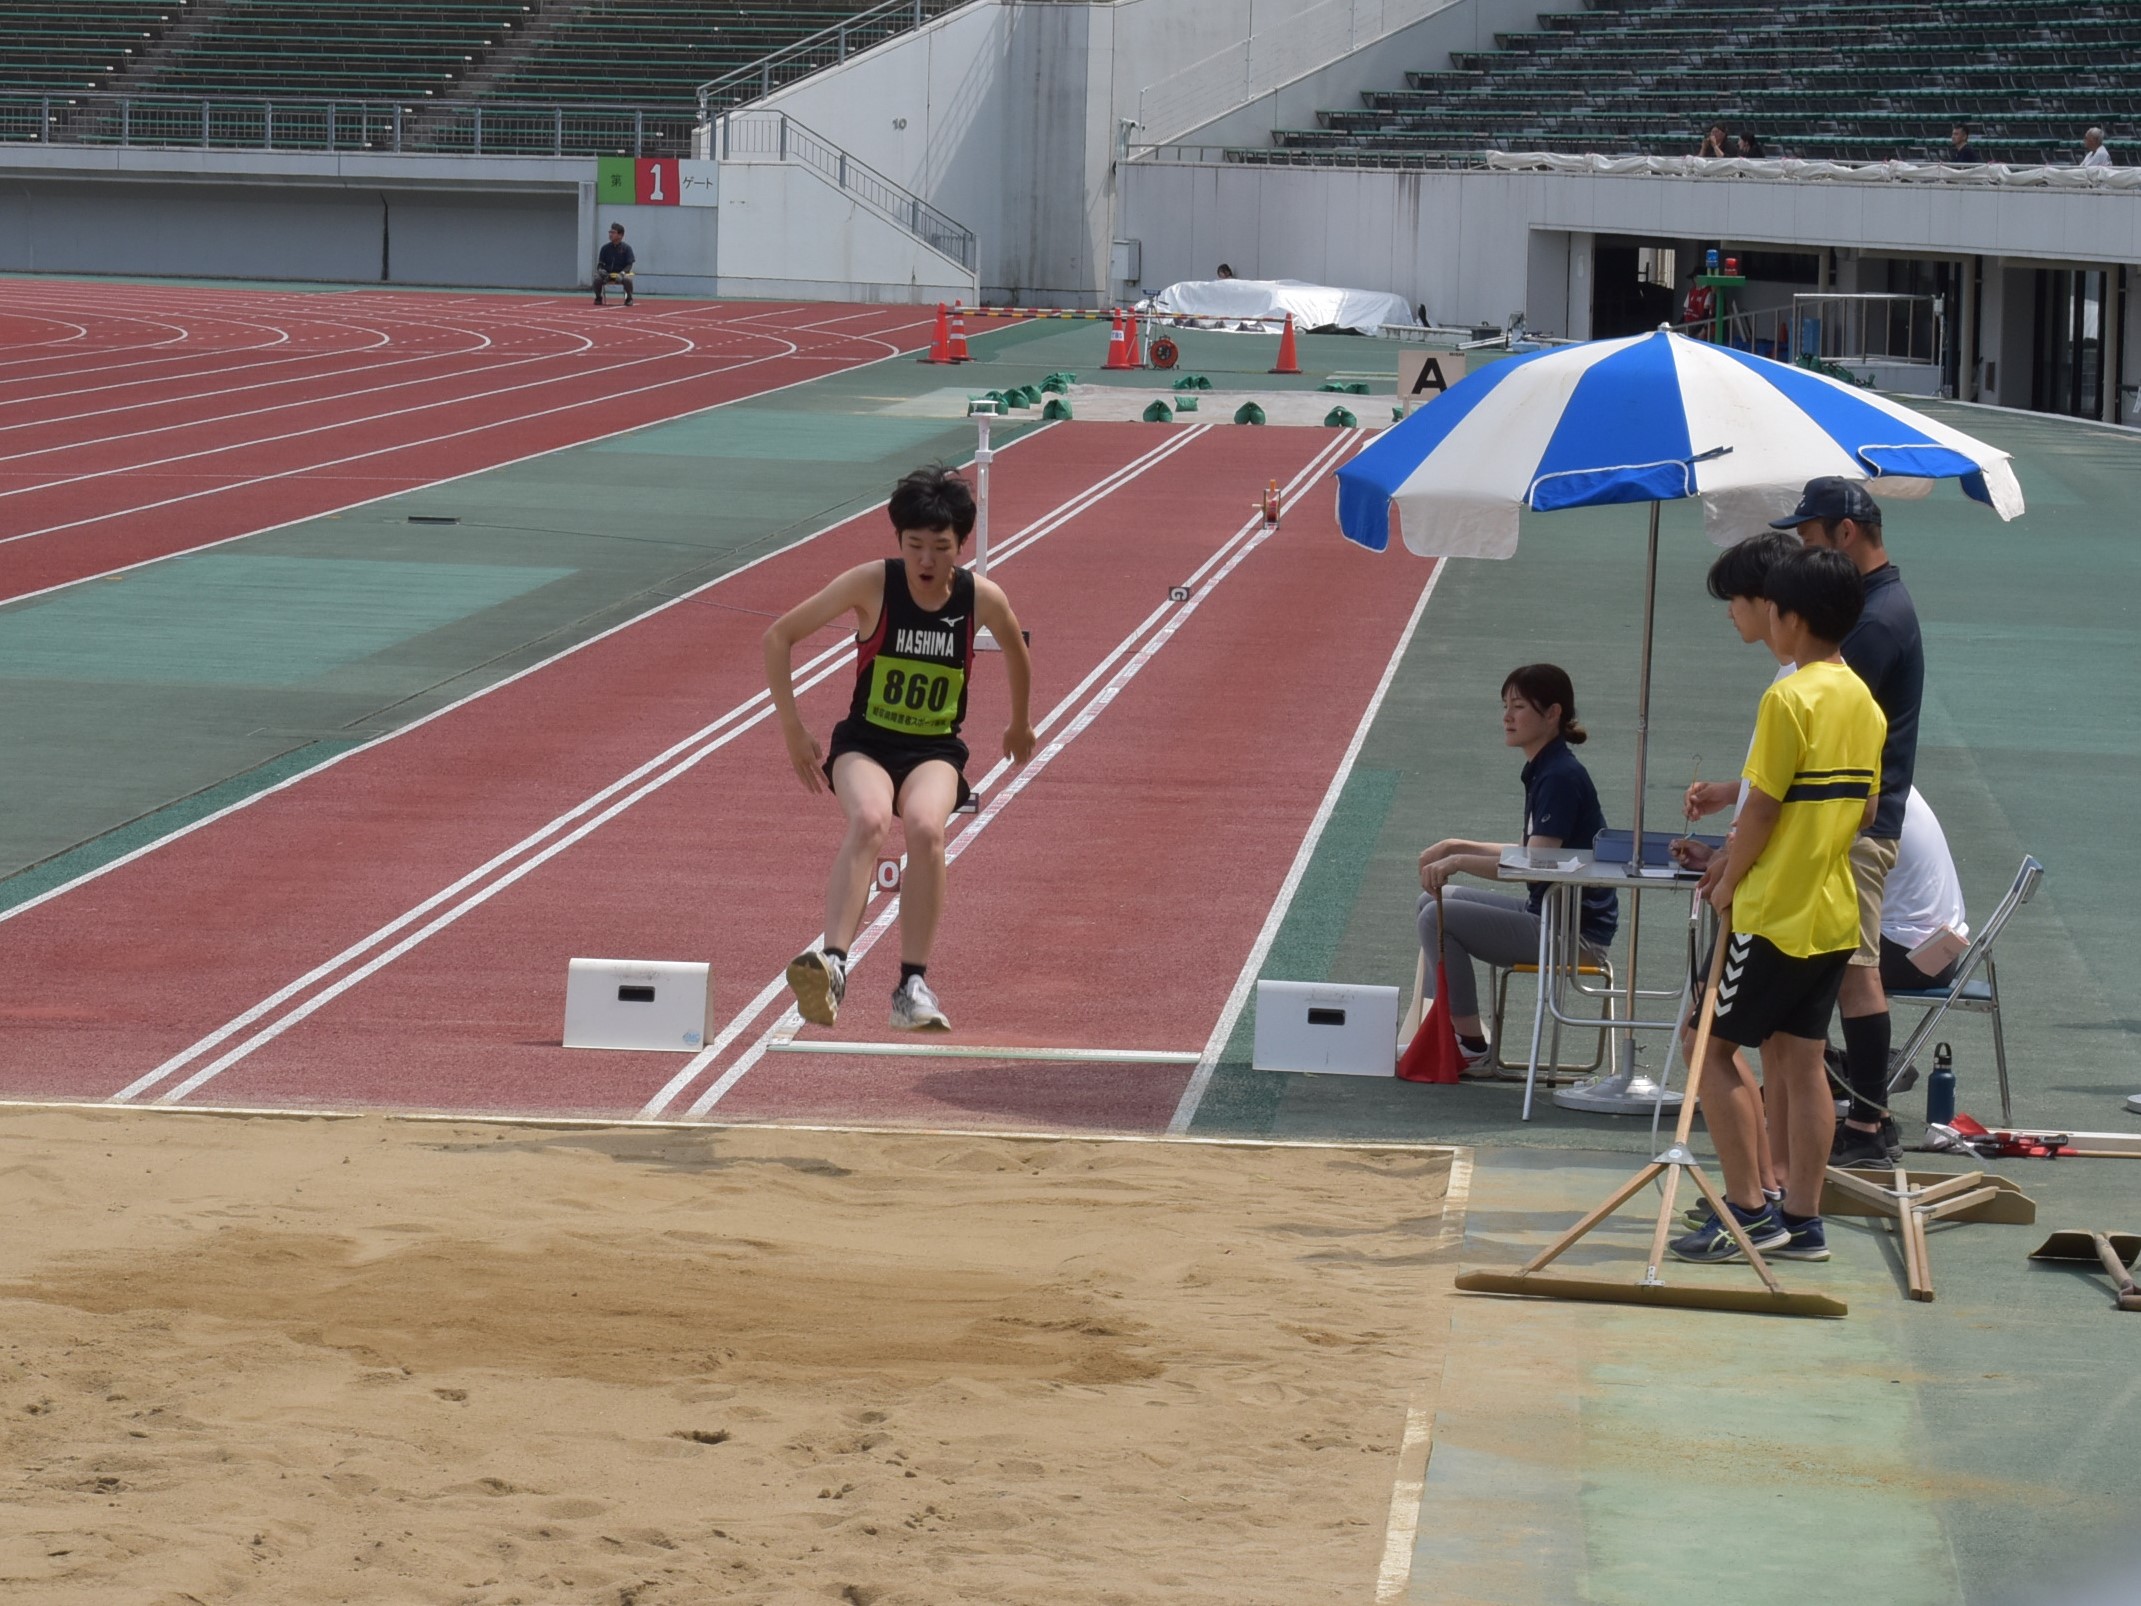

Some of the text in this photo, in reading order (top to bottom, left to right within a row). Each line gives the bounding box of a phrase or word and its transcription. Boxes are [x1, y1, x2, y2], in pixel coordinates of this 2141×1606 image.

[650, 163, 664, 201] 1
[682, 176, 713, 189] ゲート
[1411, 357, 1448, 395] A
[895, 629, 954, 657] HASHIMA
[883, 669, 949, 712] 860
[878, 861, 899, 888] 0
